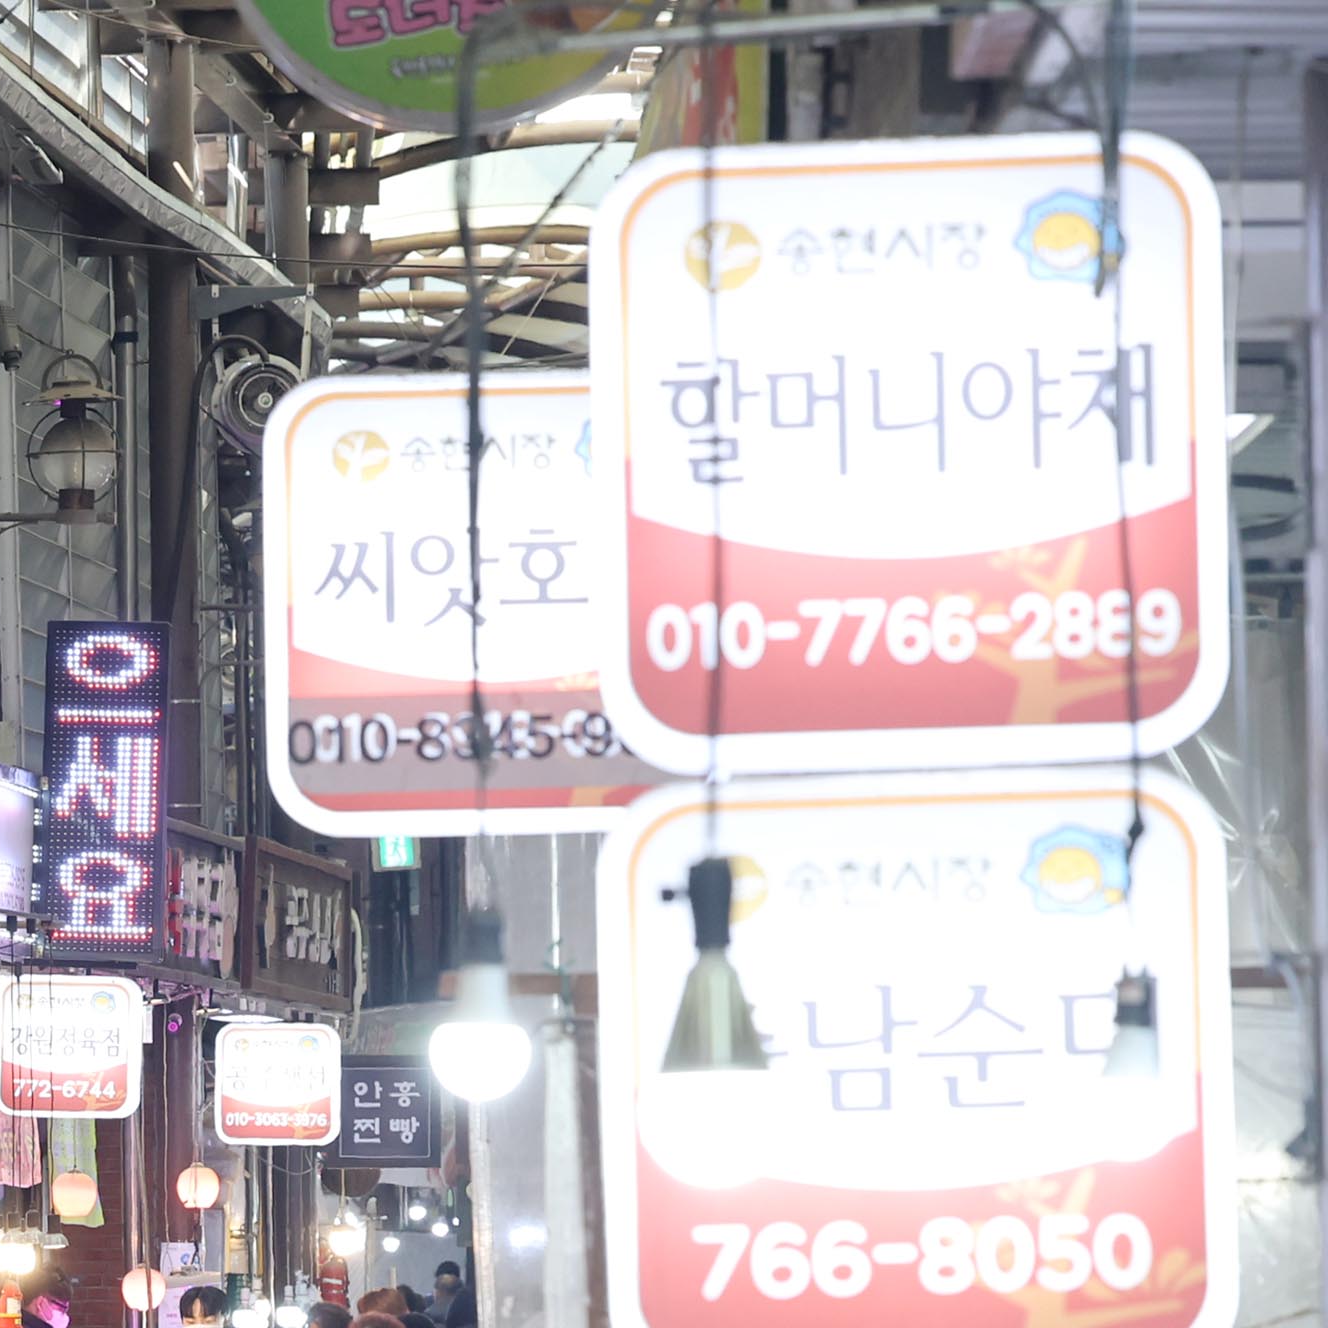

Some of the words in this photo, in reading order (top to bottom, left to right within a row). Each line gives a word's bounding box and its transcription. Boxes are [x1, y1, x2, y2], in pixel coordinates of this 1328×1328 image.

[776, 220, 987, 274] 송현시장
[661, 344, 1158, 483] 할머니야채
[644, 588, 1184, 671] 010-7766-2889
[782, 856, 996, 907] 송현시장
[11, 1025, 121, 1058] 강원정육점
[13, 1078, 117, 1099] 772-6744
[353, 1080, 421, 1109] 안흥
[353, 1116, 421, 1145] 찐빵
[690, 1211, 1153, 1302] 766-8050
